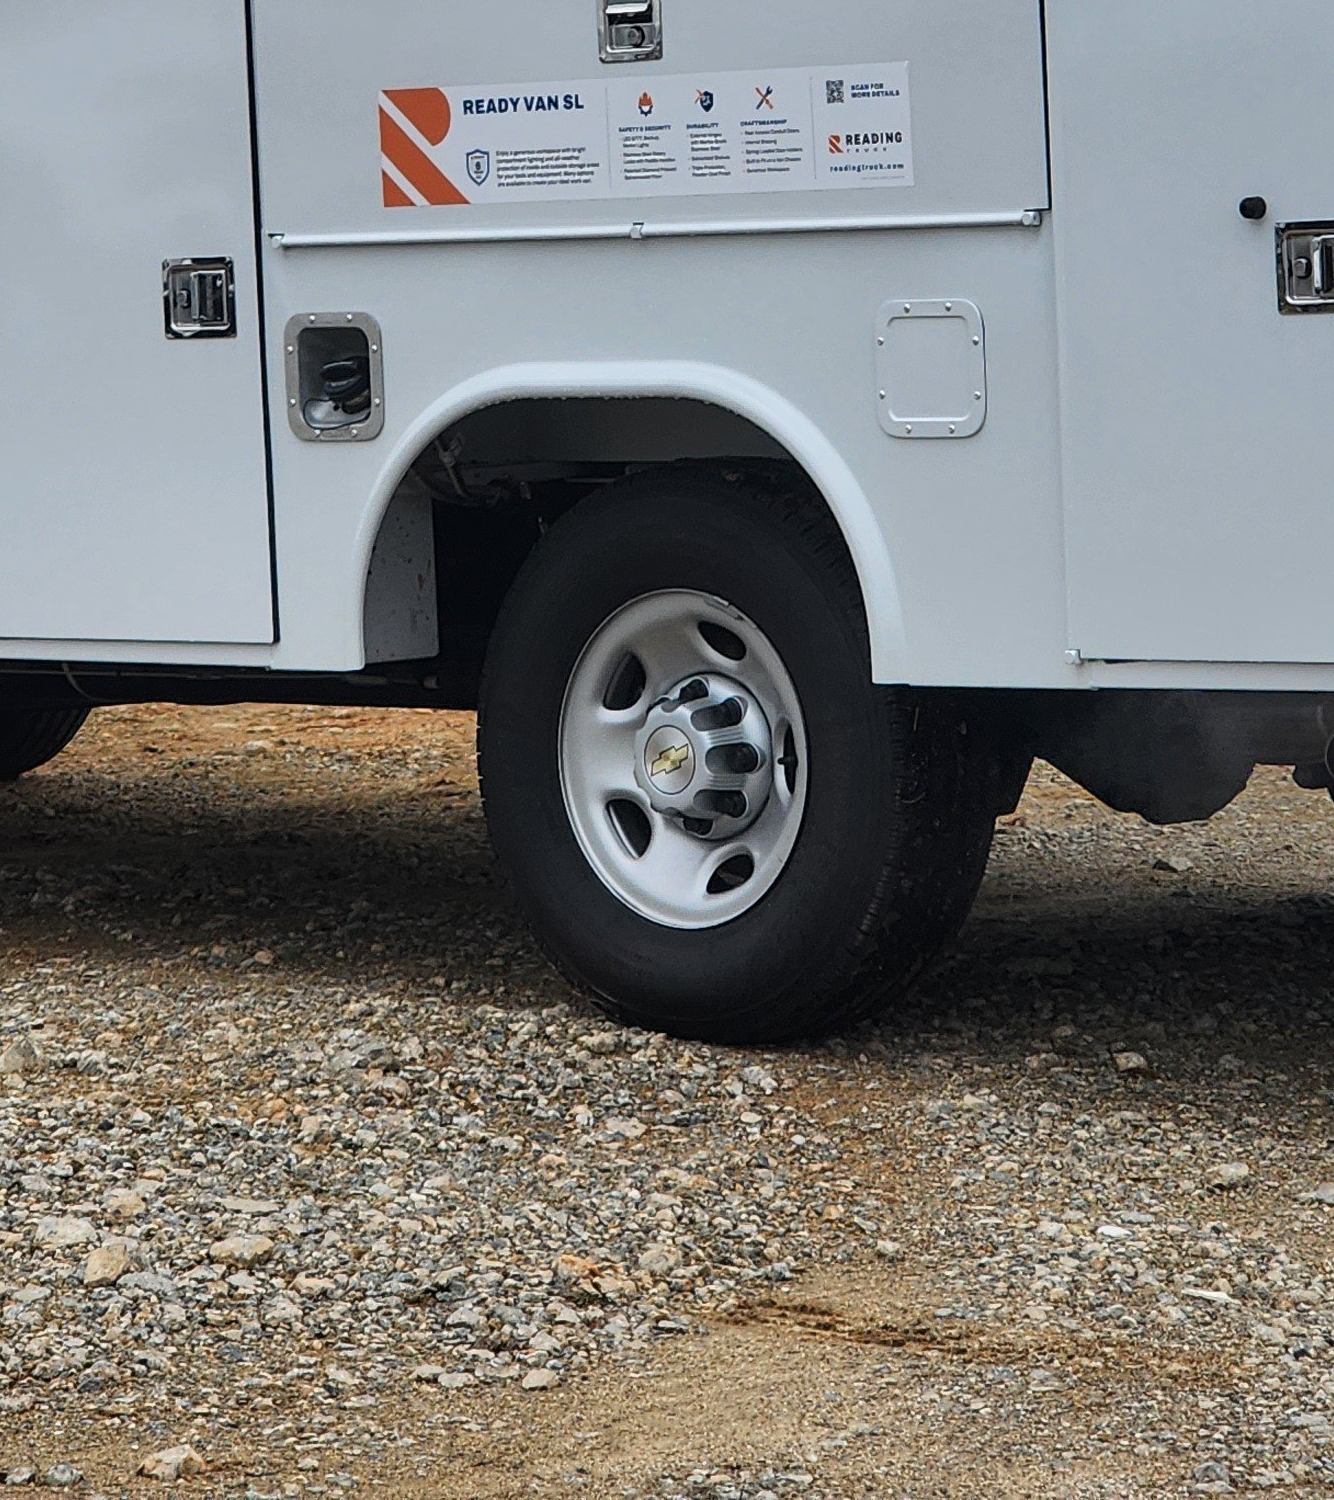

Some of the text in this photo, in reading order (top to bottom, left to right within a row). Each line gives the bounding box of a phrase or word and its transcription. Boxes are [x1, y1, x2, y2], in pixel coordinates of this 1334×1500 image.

[463, 94, 585, 115] READY VAN SL
[845, 131, 903, 146] READING
